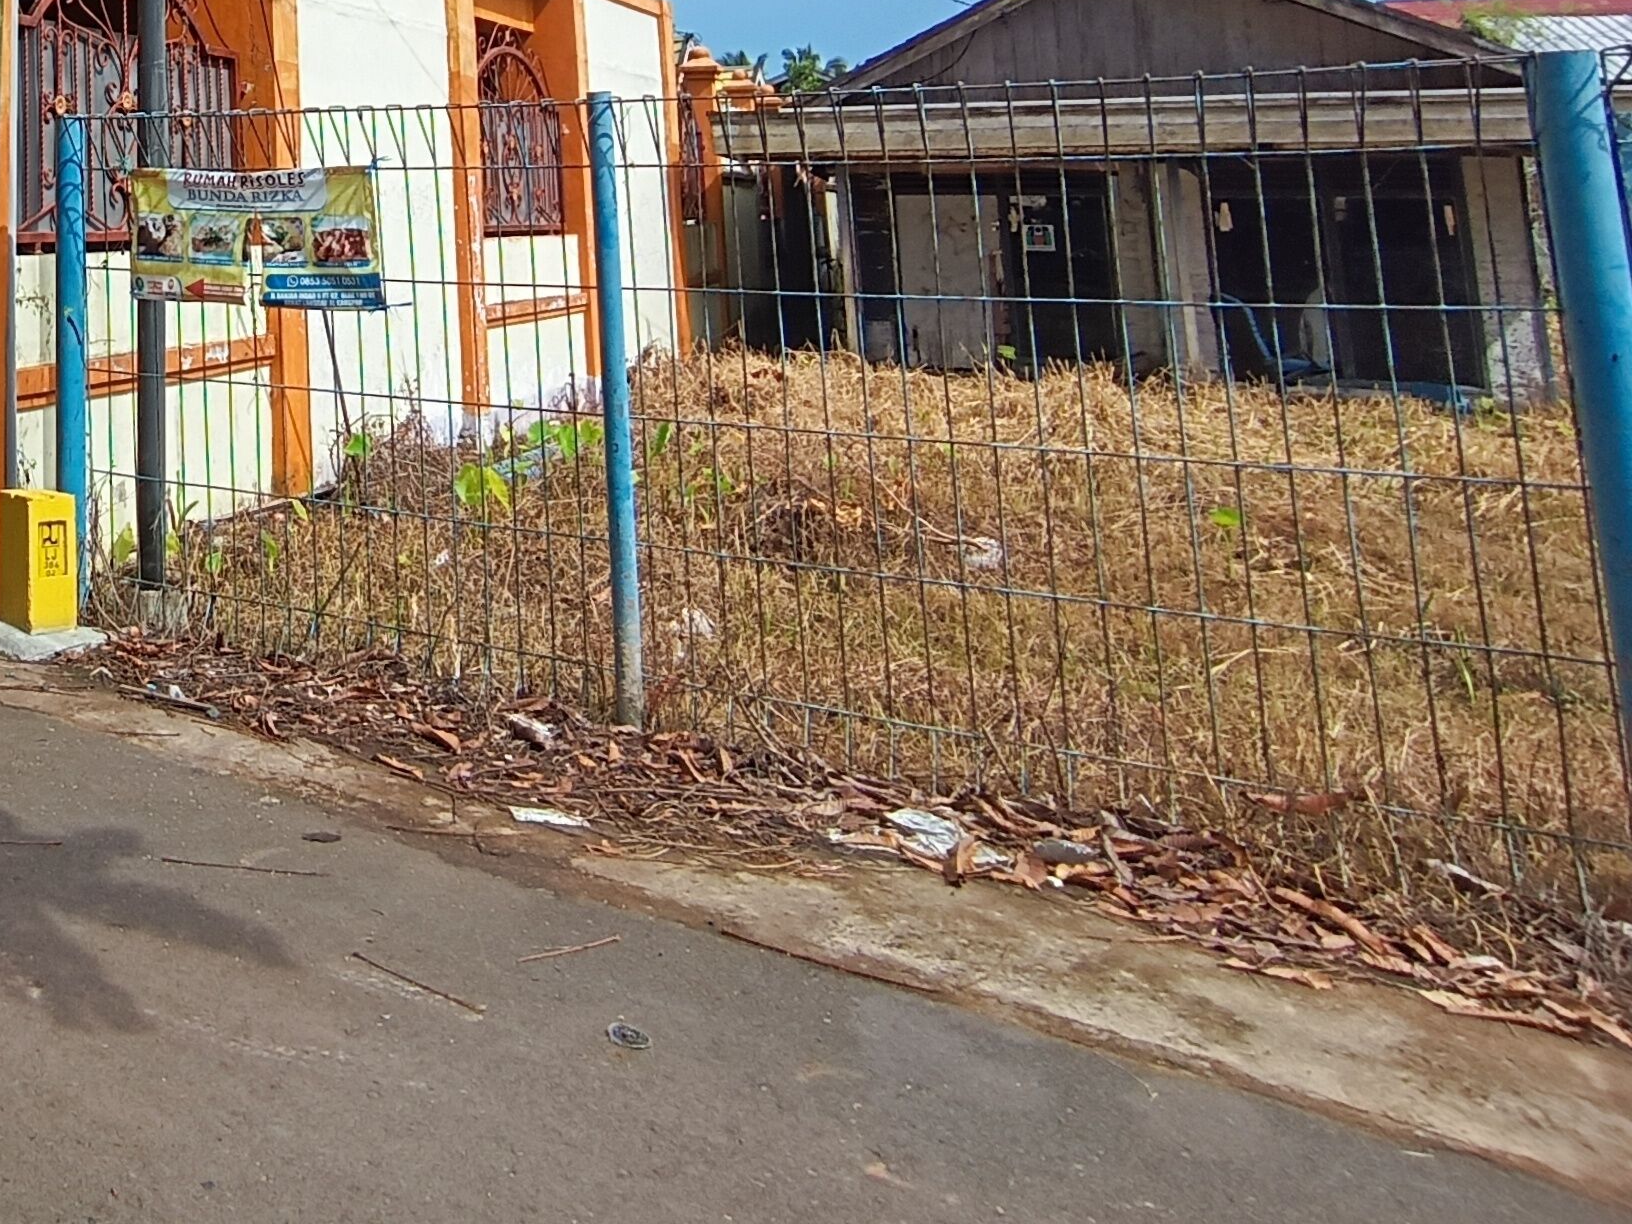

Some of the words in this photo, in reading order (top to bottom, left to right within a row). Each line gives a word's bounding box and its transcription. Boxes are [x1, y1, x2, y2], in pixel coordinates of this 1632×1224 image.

[183, 172, 236, 187] RUMAH
[187, 189, 248, 202] BUNDA
[250, 190, 305, 202] RIZKA
